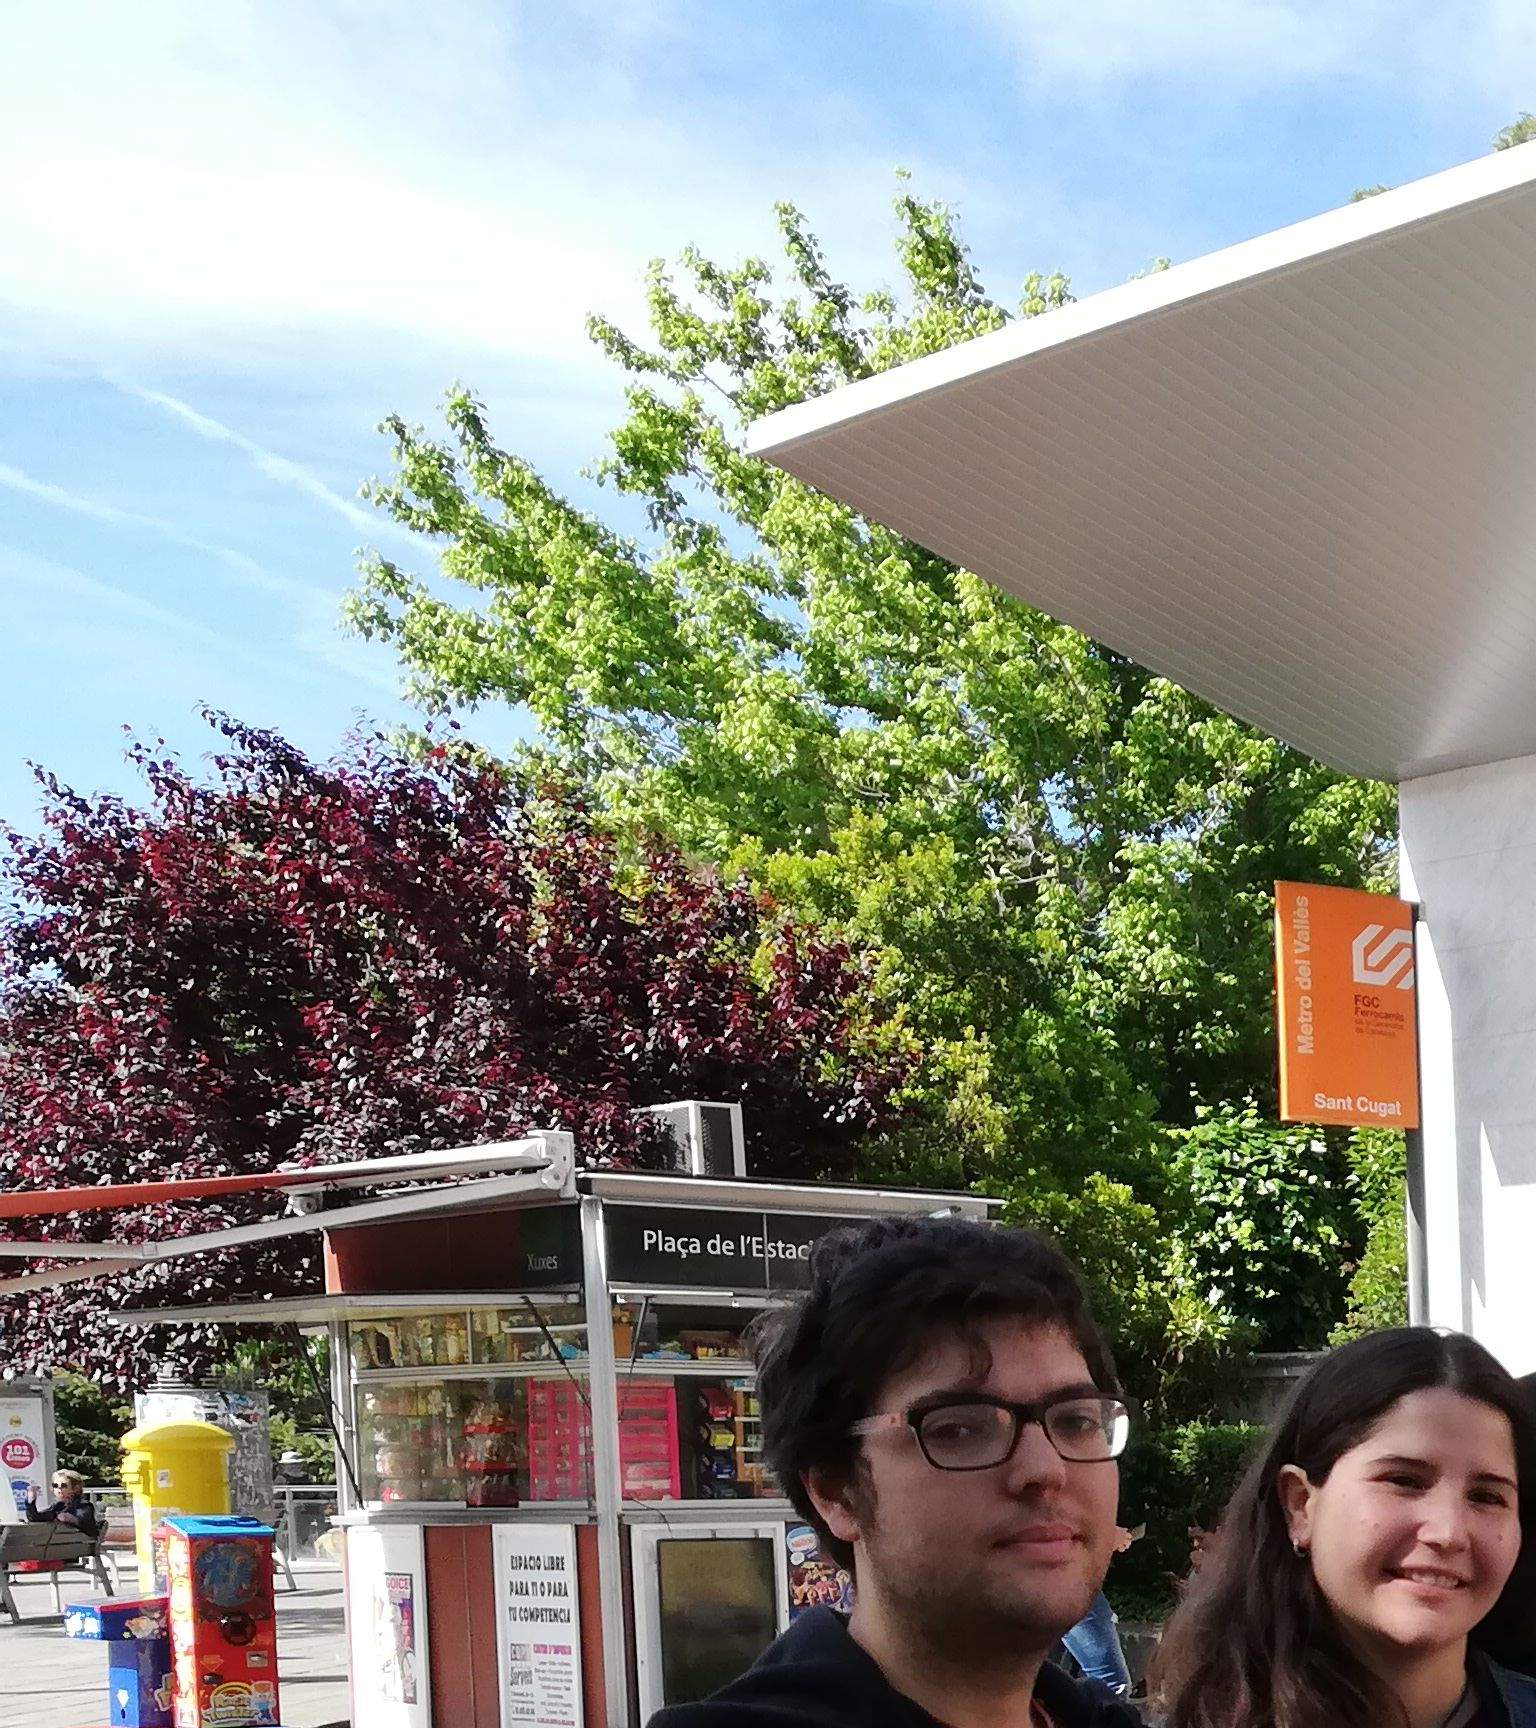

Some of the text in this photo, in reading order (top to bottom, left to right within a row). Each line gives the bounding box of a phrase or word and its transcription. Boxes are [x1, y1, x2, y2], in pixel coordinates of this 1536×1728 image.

[1295, 960, 1312, 988] del
[1354, 994, 1380, 1009] FGC
[1297, 994, 1314, 1055] Metro
[1314, 1093, 1402, 1117] Sant Cugat
[643, 1230, 701, 1259] Plaça
[707, 1233, 734, 1255] de
[526, 1253, 559, 1272] Xuxes
[543, 1556, 566, 1571] LIBRE
[509, 1580, 529, 1597] PARA
[547, 1582, 569, 1598] PARA
[518, 1607, 571, 1624] COMPETENCIA
